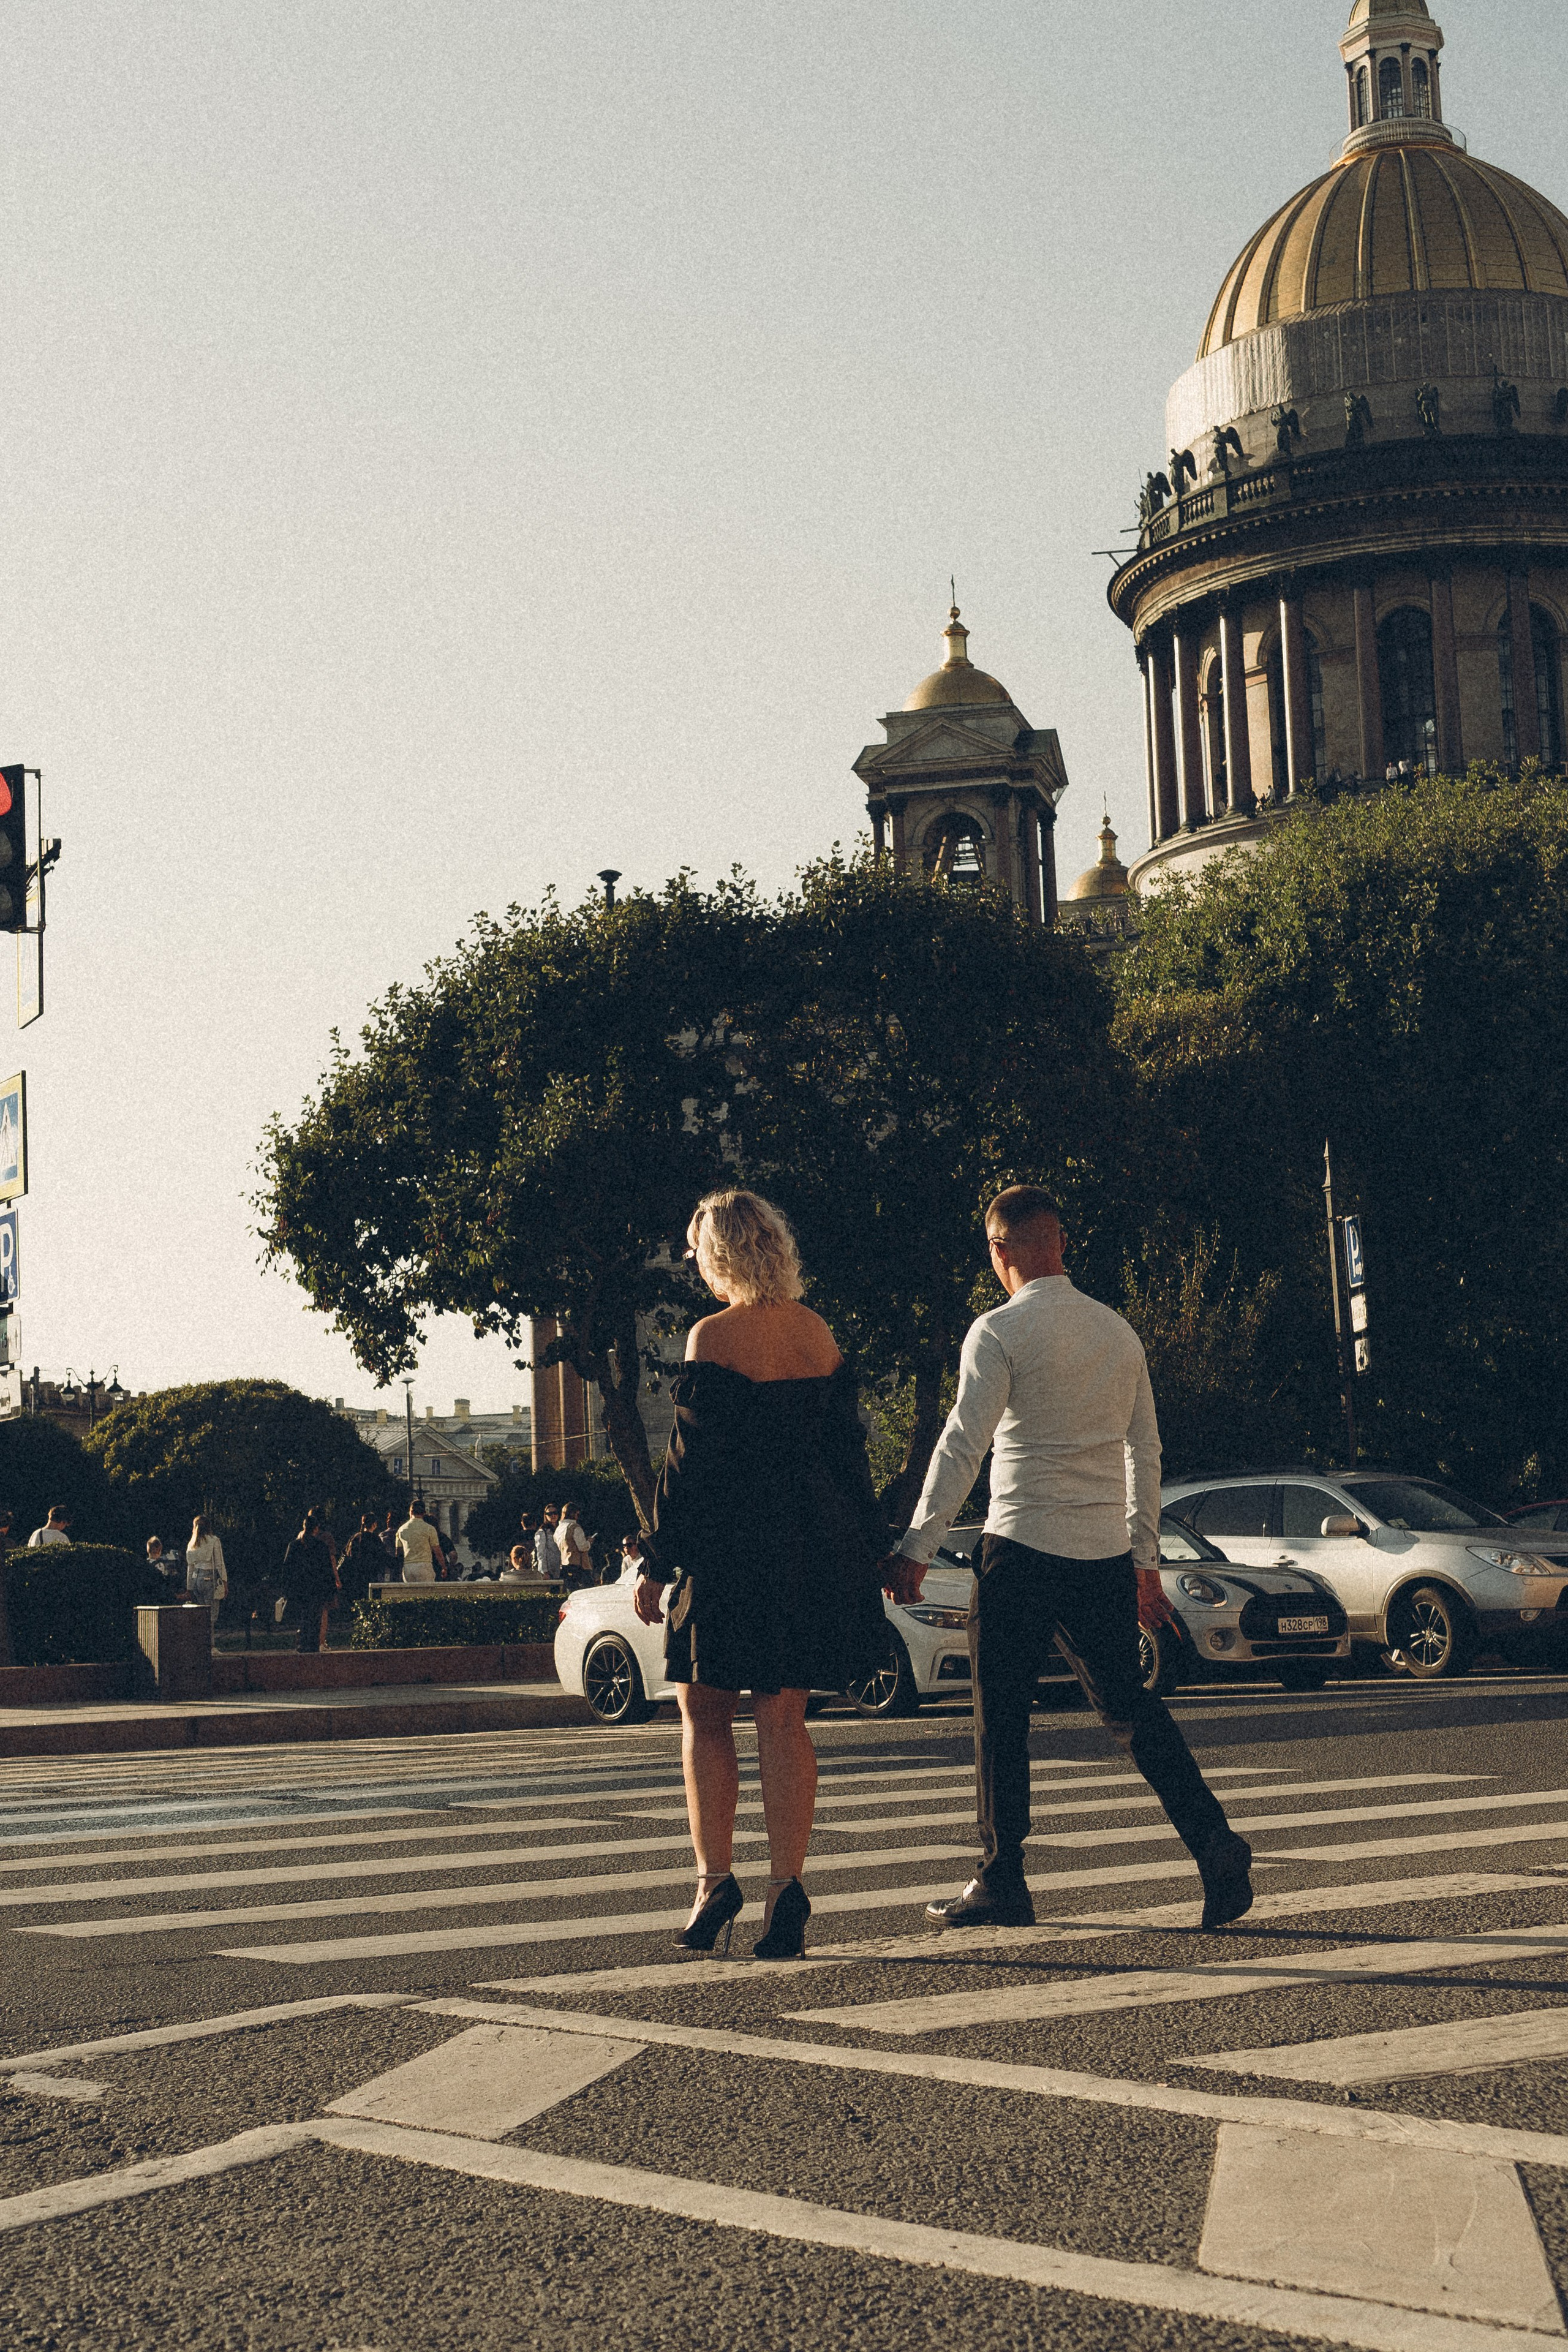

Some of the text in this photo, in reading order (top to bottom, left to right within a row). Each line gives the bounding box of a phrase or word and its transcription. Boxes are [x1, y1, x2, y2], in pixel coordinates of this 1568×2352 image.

[0, 1223, 13, 1292] P
[1349, 1225, 1359, 1278] P
[1315, 1617, 1327, 1627] 198
